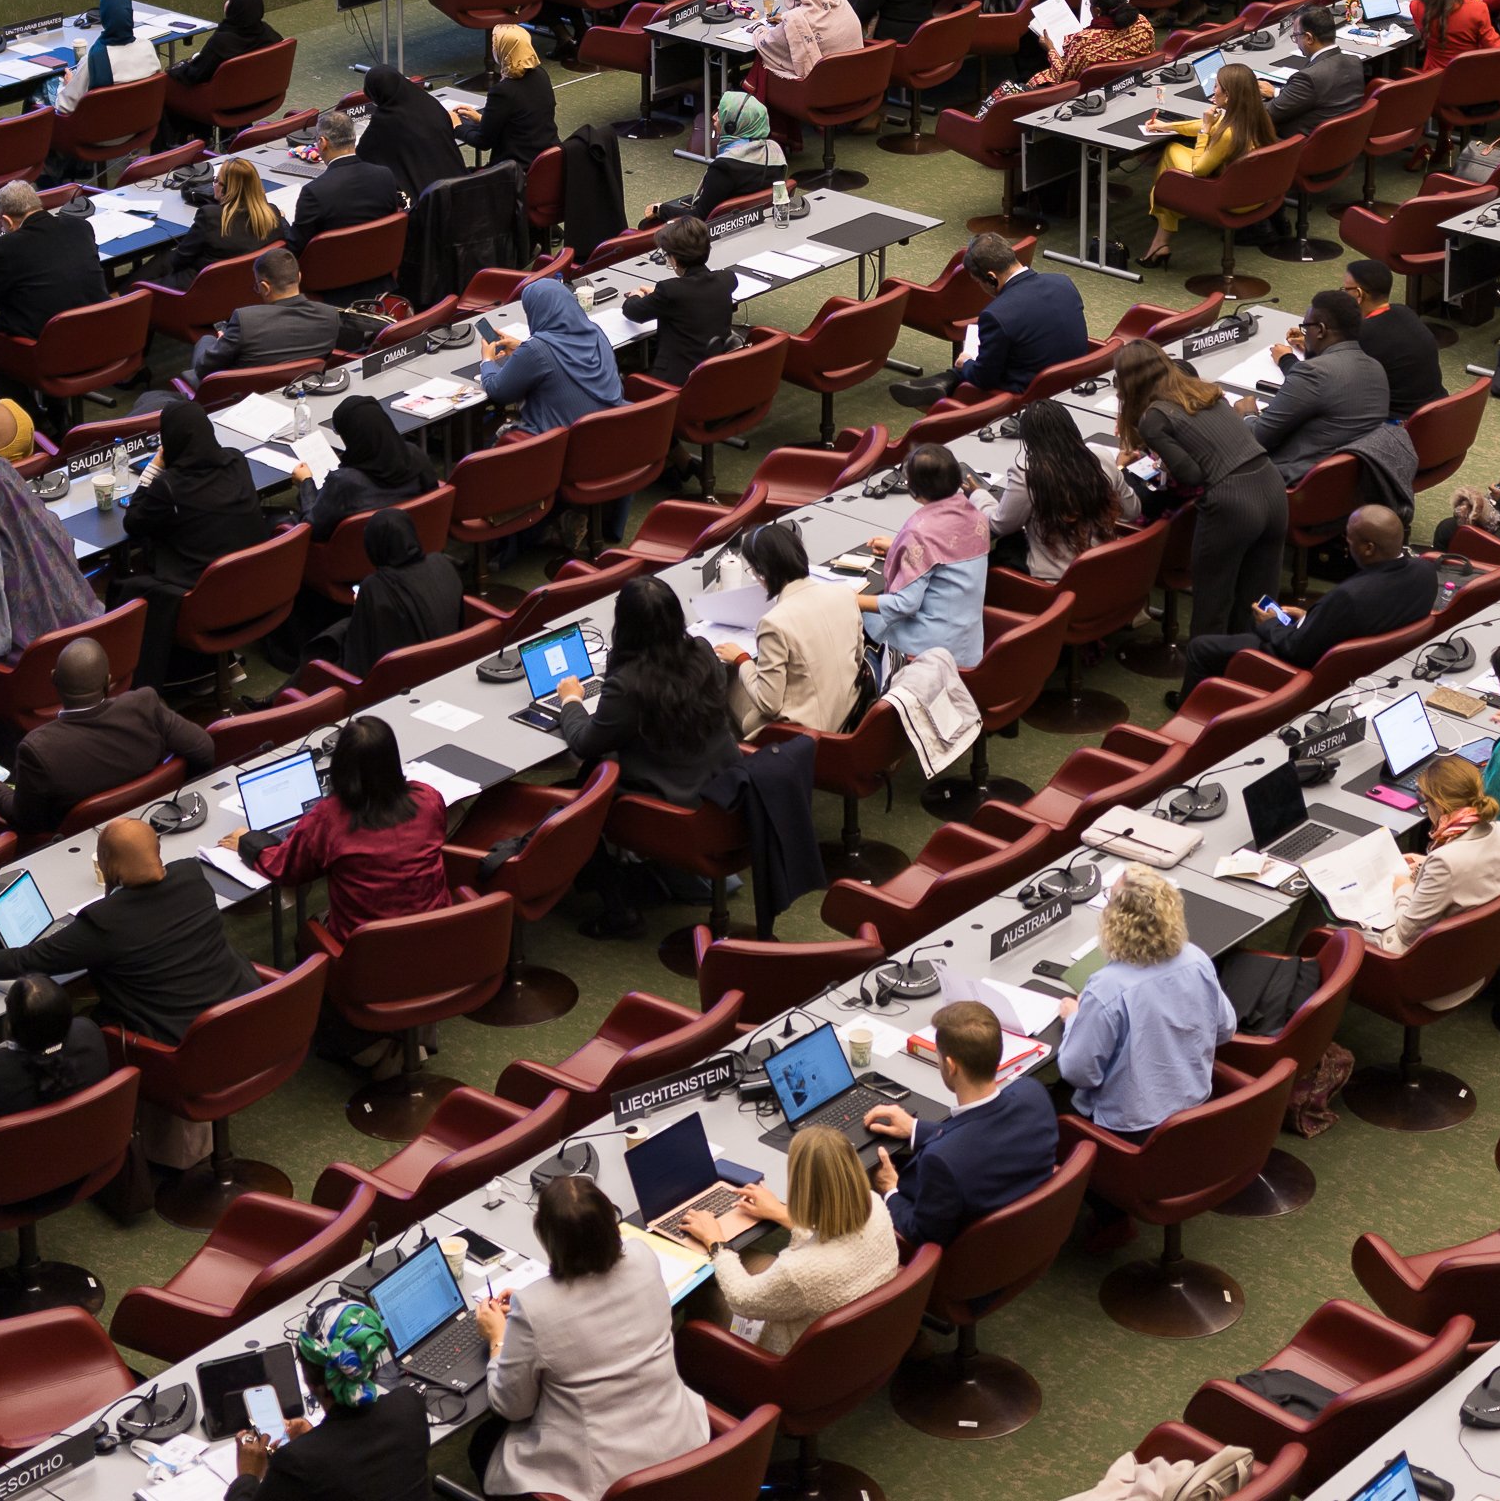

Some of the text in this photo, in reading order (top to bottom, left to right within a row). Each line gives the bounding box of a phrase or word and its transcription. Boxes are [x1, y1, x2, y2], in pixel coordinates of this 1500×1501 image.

[675, 4, 700, 22] DJIBOUTI
[5, 17, 62, 36] UNITED ARAB EMIRATES
[1112, 75, 1135, 92] PAKISTAN
[346, 105, 366, 117] IRAN
[709, 210, 760, 237] UZBEKISTAN
[1192, 327, 1240, 351] ZIMBABWE
[383, 346, 408, 364] OMAN
[70, 449, 104, 473] SAUDI
[1307, 732, 1347, 758] AUSTRIA
[1001, 903, 1063, 948] AUSTRALIA
[619, 1064, 731, 1116] LIECHTENSTEIN
